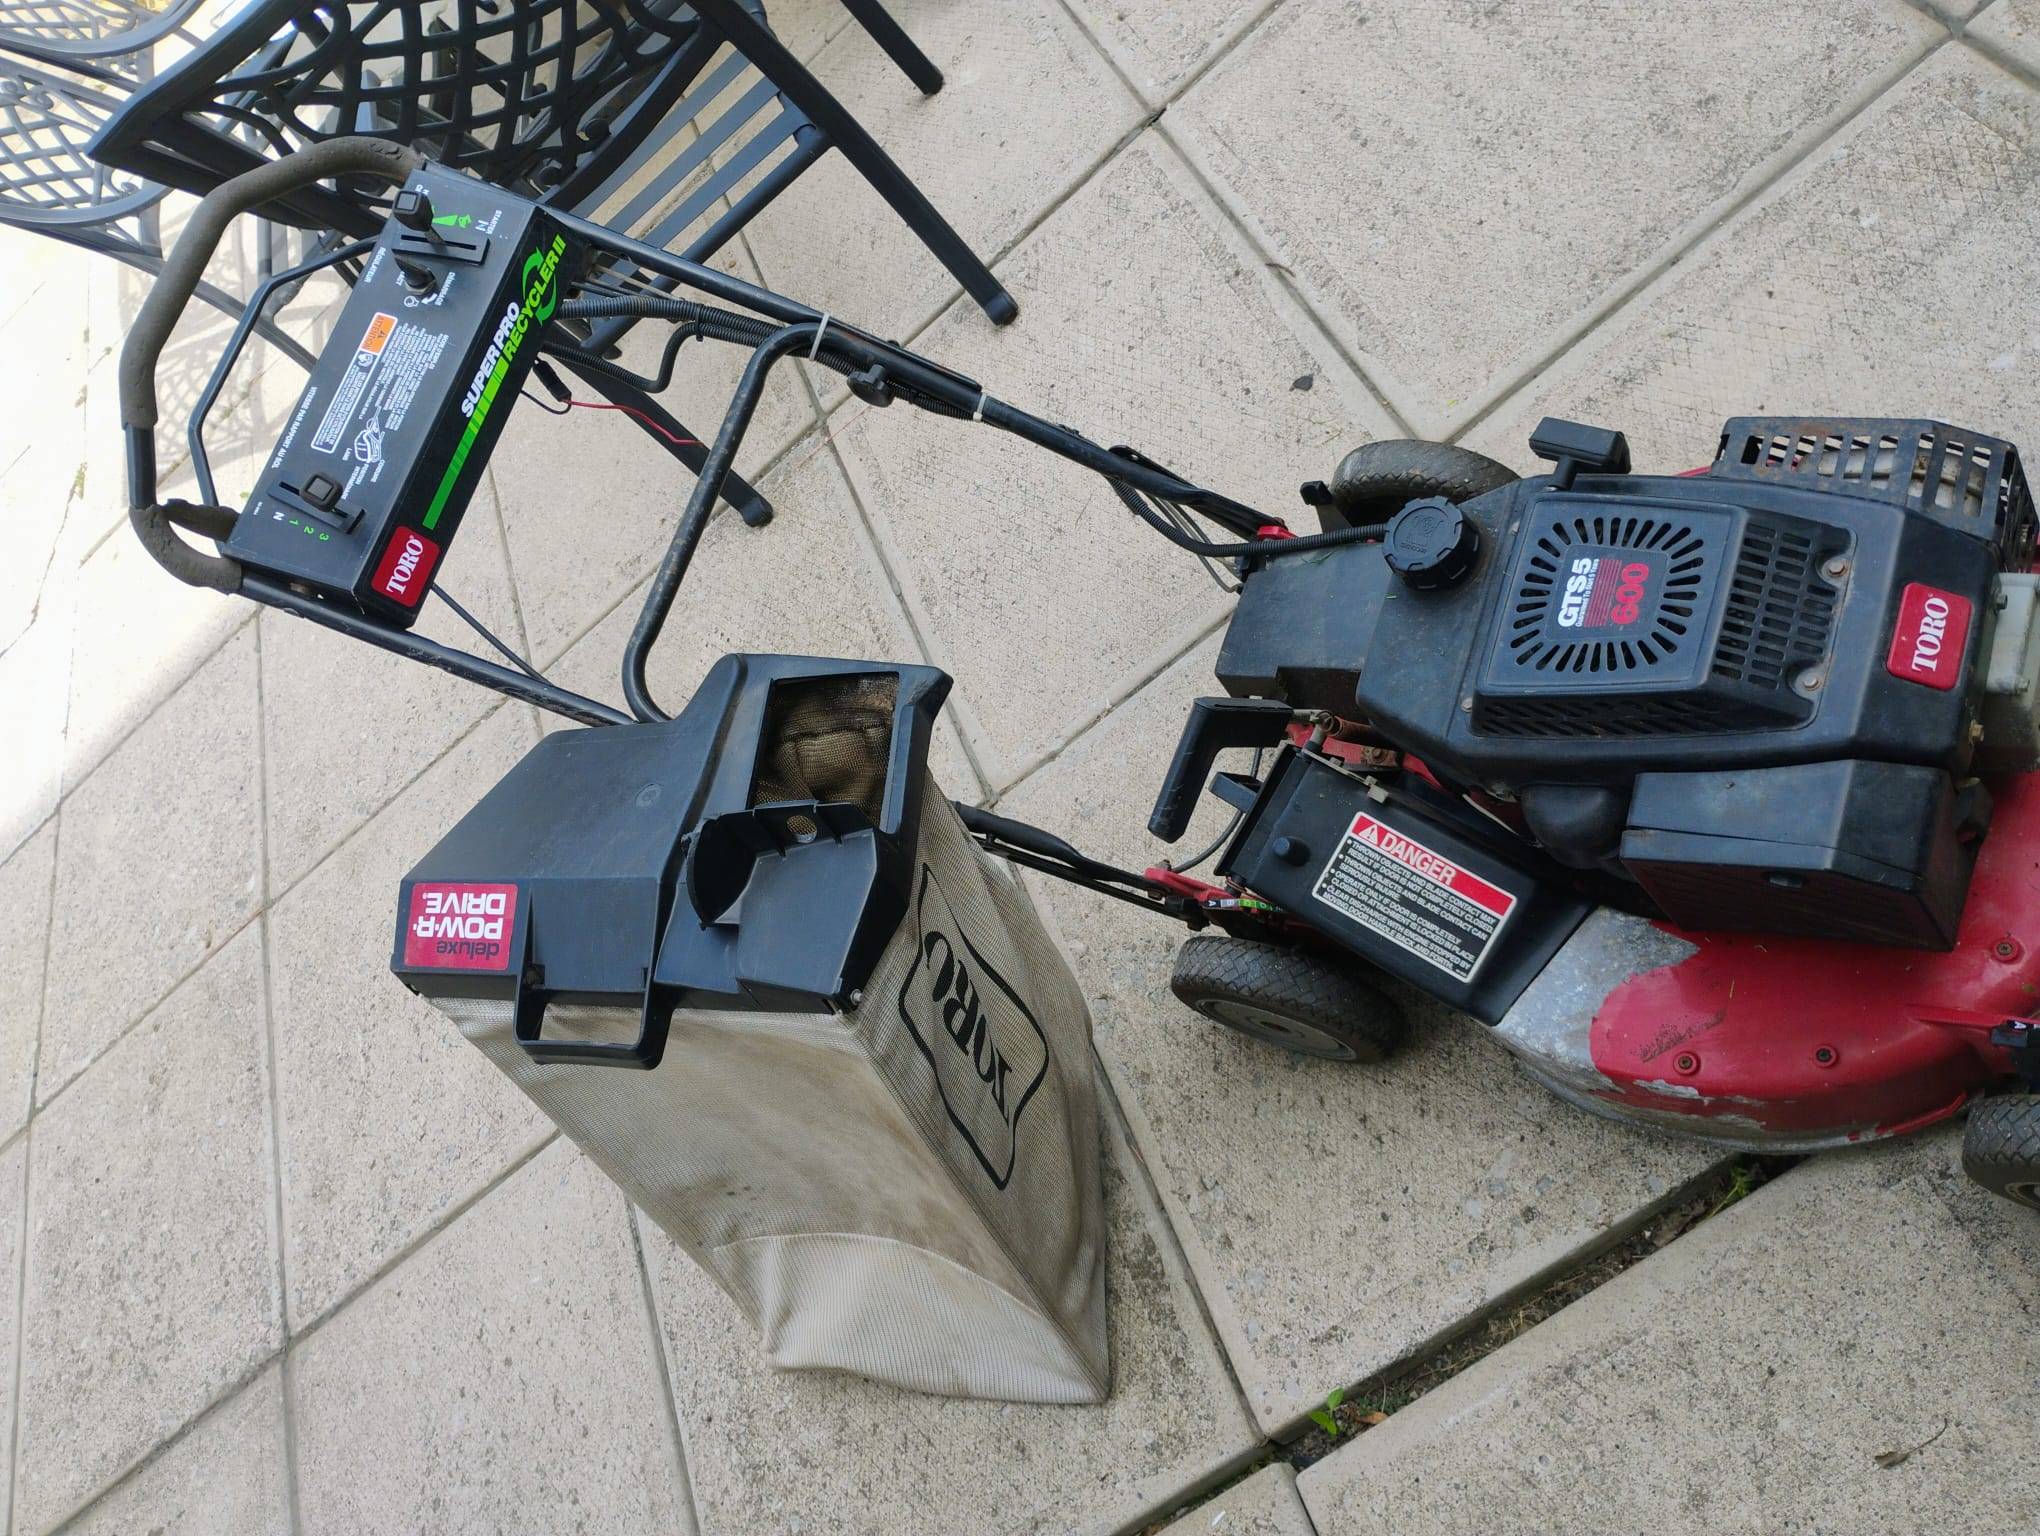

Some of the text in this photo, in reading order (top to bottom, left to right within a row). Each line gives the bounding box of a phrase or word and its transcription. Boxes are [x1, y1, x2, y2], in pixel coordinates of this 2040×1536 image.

[486, 210, 502, 234] STARTER
[502, 233, 567, 361] RECYCLER II
[461, 302, 520, 418] SUPER PRO
[271, 385, 318, 469] VITESSE PAR RAPPORT AU SOL
[273, 511, 285, 521] N
[304, 526, 314, 534] 2
[319, 533, 329, 541] 3
[386, 538, 423, 595] TORO
[1611, 563, 1649, 625] 600
[1911, 597, 1949, 672] TORO
[1338, 863, 1375, 887] SERIOUSLY
[1346, 848, 1374, 867] RESULT
[1372, 862, 1380, 870] IF
[1378, 865, 1400, 881] DOOR
[1398, 876, 1407, 885] IS
[1405, 880, 1421, 893] NOT
[1420, 888, 1465, 918] COMPLETELY
[1351, 841, 1496, 925] THROWN OBJECTS AND BLADE CONTACT MAY
[1378, 832, 1457, 885] DANGER
[1322, 891, 1349, 910] MOVING
[1347, 906, 1368, 921] DOOR
[1367, 917, 1396, 936] HANDLE
[1394, 932, 1415, 947] BACK
[1414, 942, 1430, 955] AND
[1325, 885, 1470, 970] CLEAR DISCHARGE WITH ENGINE STOPPED BY
[1329, 877, 1358, 897] CLOSED
[1356, 892, 1369, 902] OR
[1367, 898, 1411, 926] ATTACHMENT
[1409, 921, 1417, 930] IS
[1416, 925, 1445, 945] LOCKED
[1443, 940, 1452, 949] IN
[1334, 870, 1461, 945] OPERATE ONLY IF DOOR IS COMPLETELY
[1342, 856, 1488, 940] THROWN OBJECTS AND BLADE CONTACT CAN
[436, 940, 499, 961] deluxe
